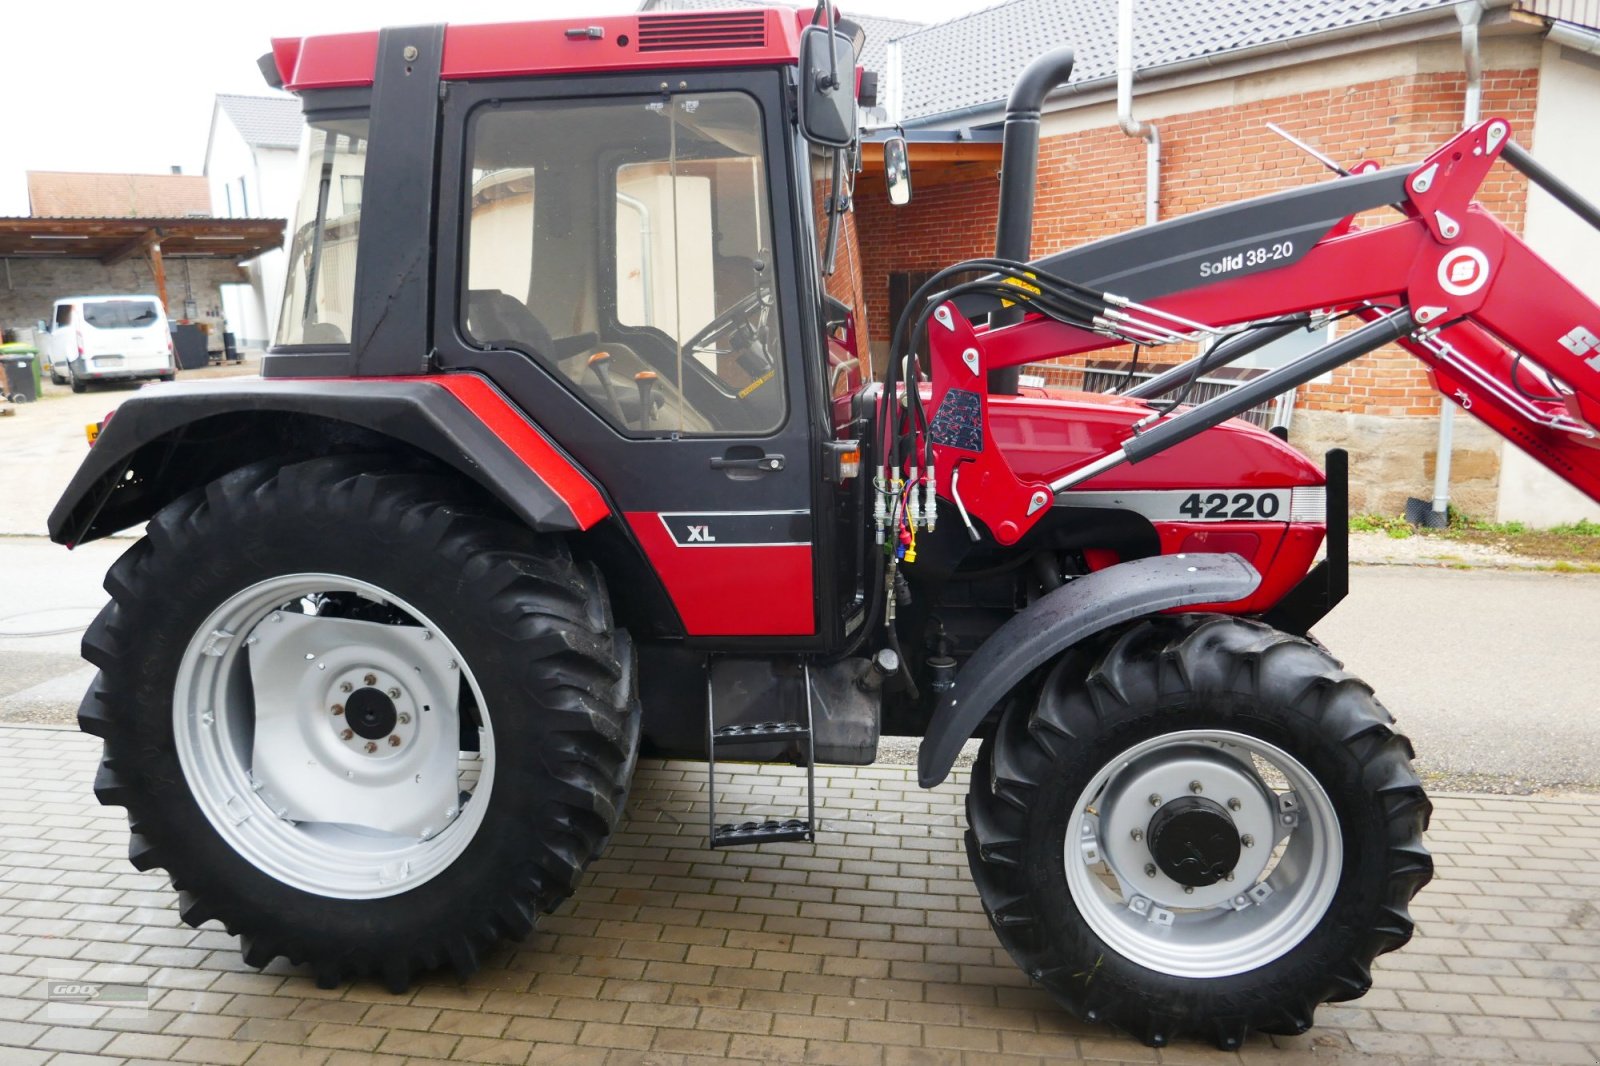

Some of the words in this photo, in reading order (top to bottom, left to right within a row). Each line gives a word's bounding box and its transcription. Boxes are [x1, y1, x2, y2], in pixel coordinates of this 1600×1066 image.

[1199, 252, 1244, 277] Solid
[1246, 241, 1294, 266] 38-20
[1179, 493, 1280, 518] 4220
[686, 525, 716, 542] XL
